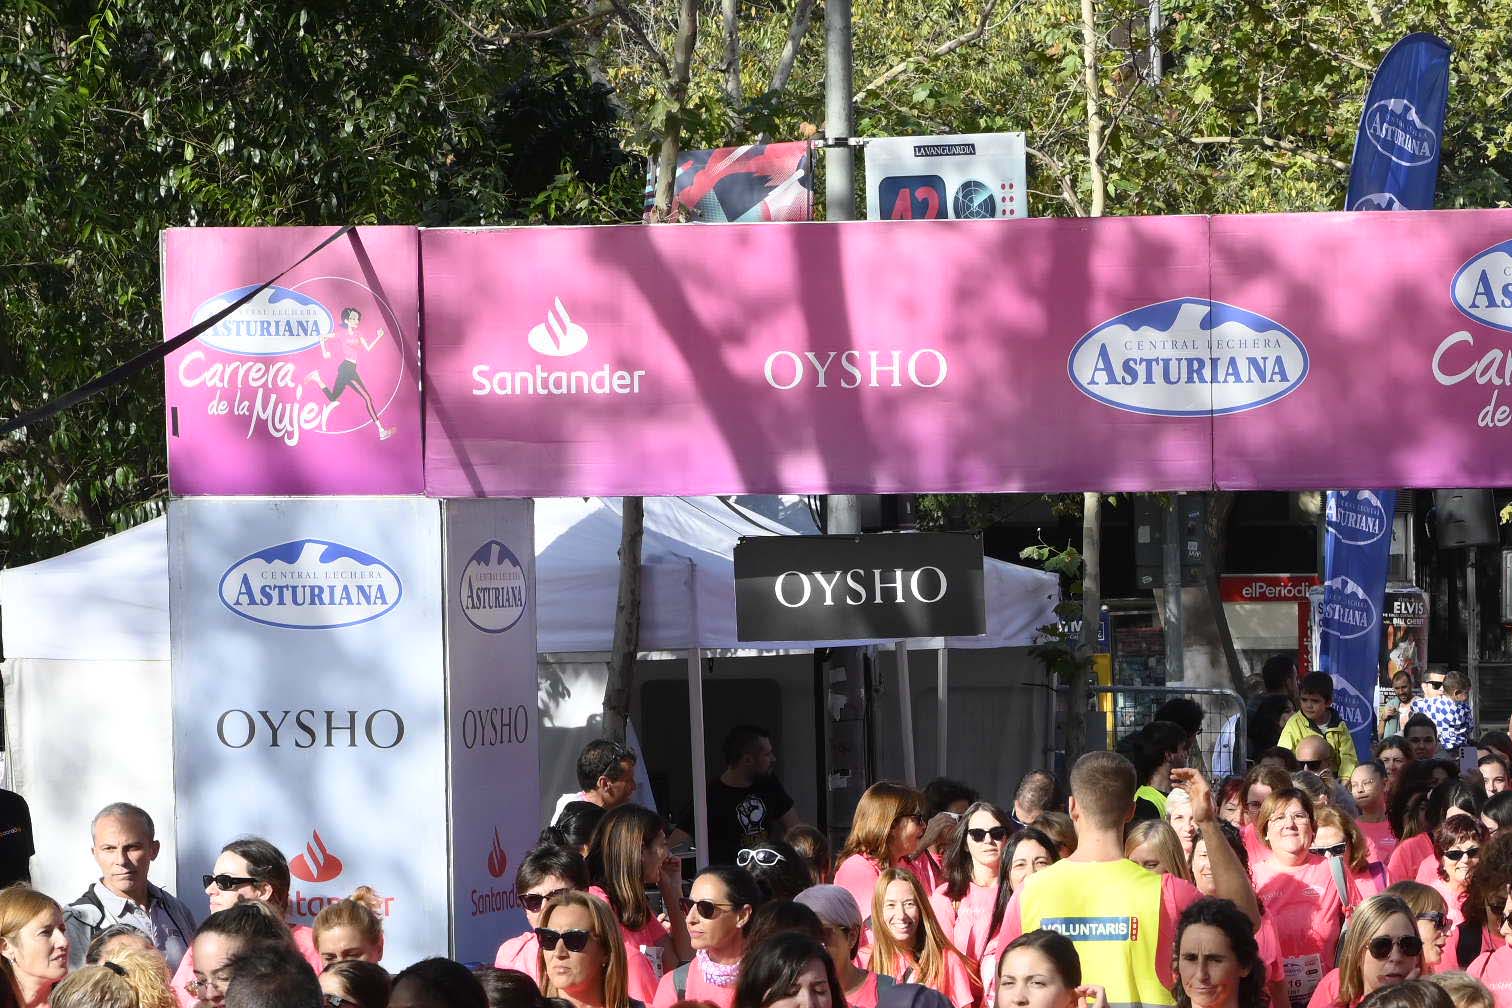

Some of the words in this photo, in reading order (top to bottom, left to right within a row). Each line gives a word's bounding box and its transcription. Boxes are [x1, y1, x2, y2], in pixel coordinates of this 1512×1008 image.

[1124, 338, 1198, 351] CENTRAL
[1207, 337, 1283, 351] LECHERA
[178, 352, 297, 388] Carrera
[472, 365, 645, 395] Santander
[763, 349, 949, 390] OYSHO
[1087, 343, 1291, 386] ASTURIANA
[207, 389, 229, 415] de
[233, 387, 250, 416] la
[246, 386, 340, 447] Mujer
[1477, 389, 1511, 428] de
[233, 572, 388, 606] ASTURIANA
[261, 571, 319, 580] CENTRAL
[325, 570, 383, 580] LECHERA
[465, 574, 523, 611] ASTURIANA
[774, 566, 948, 608] OYSHO
[1393, 601, 1425, 615] ELVIS
[216, 708, 405, 749] OYSHO
[463, 704, 528, 749] OYSHO
